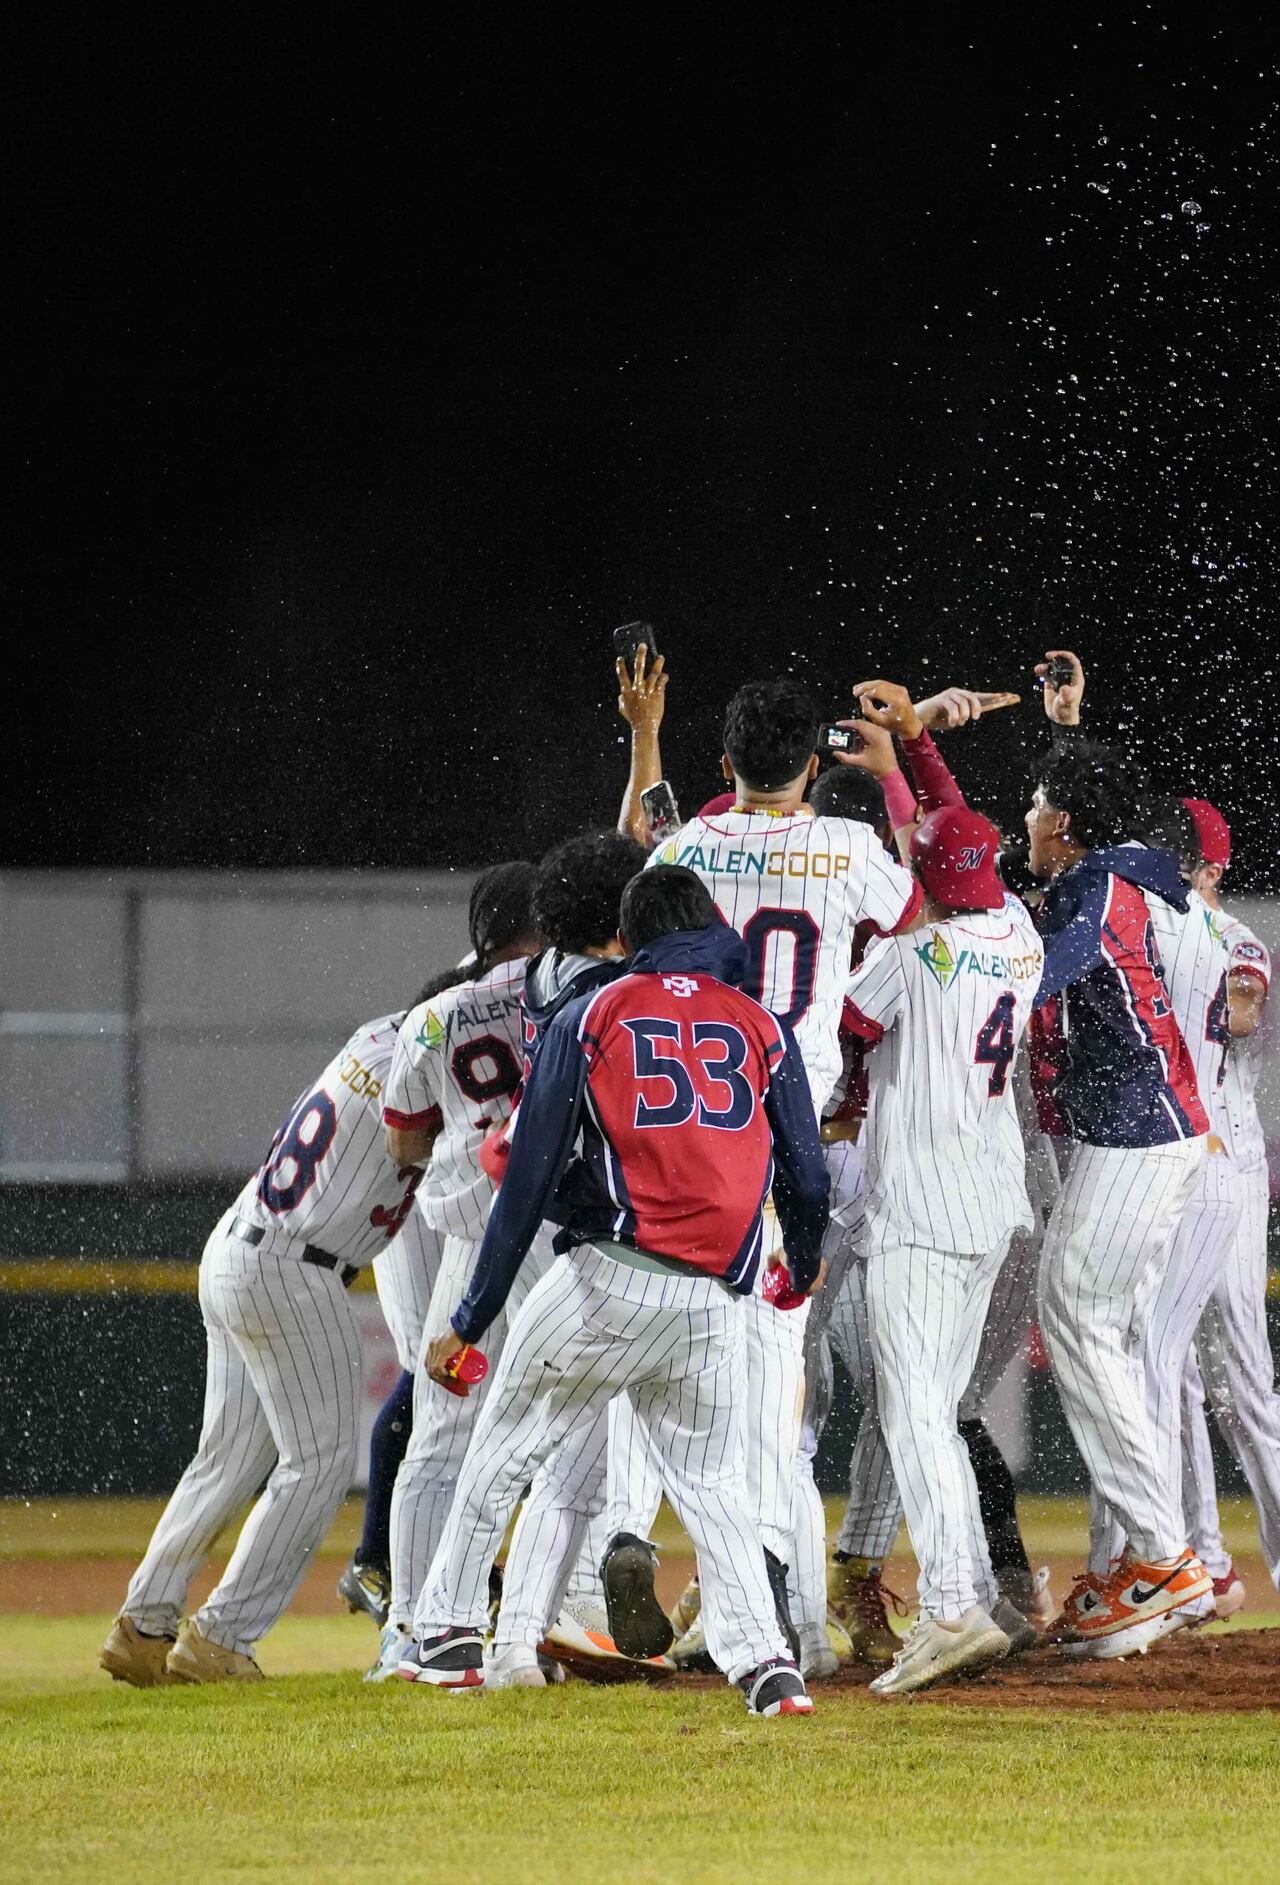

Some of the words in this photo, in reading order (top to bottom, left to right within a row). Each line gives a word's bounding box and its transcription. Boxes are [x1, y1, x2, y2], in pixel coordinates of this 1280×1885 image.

[955, 843, 988, 872] M
[713, 902, 821, 1030] 0
[416, 997, 521, 1058] VALEN
[618, 1017, 755, 1131] 53
[973, 989, 1017, 1098] 4
[256, 1087, 337, 1216] 8
